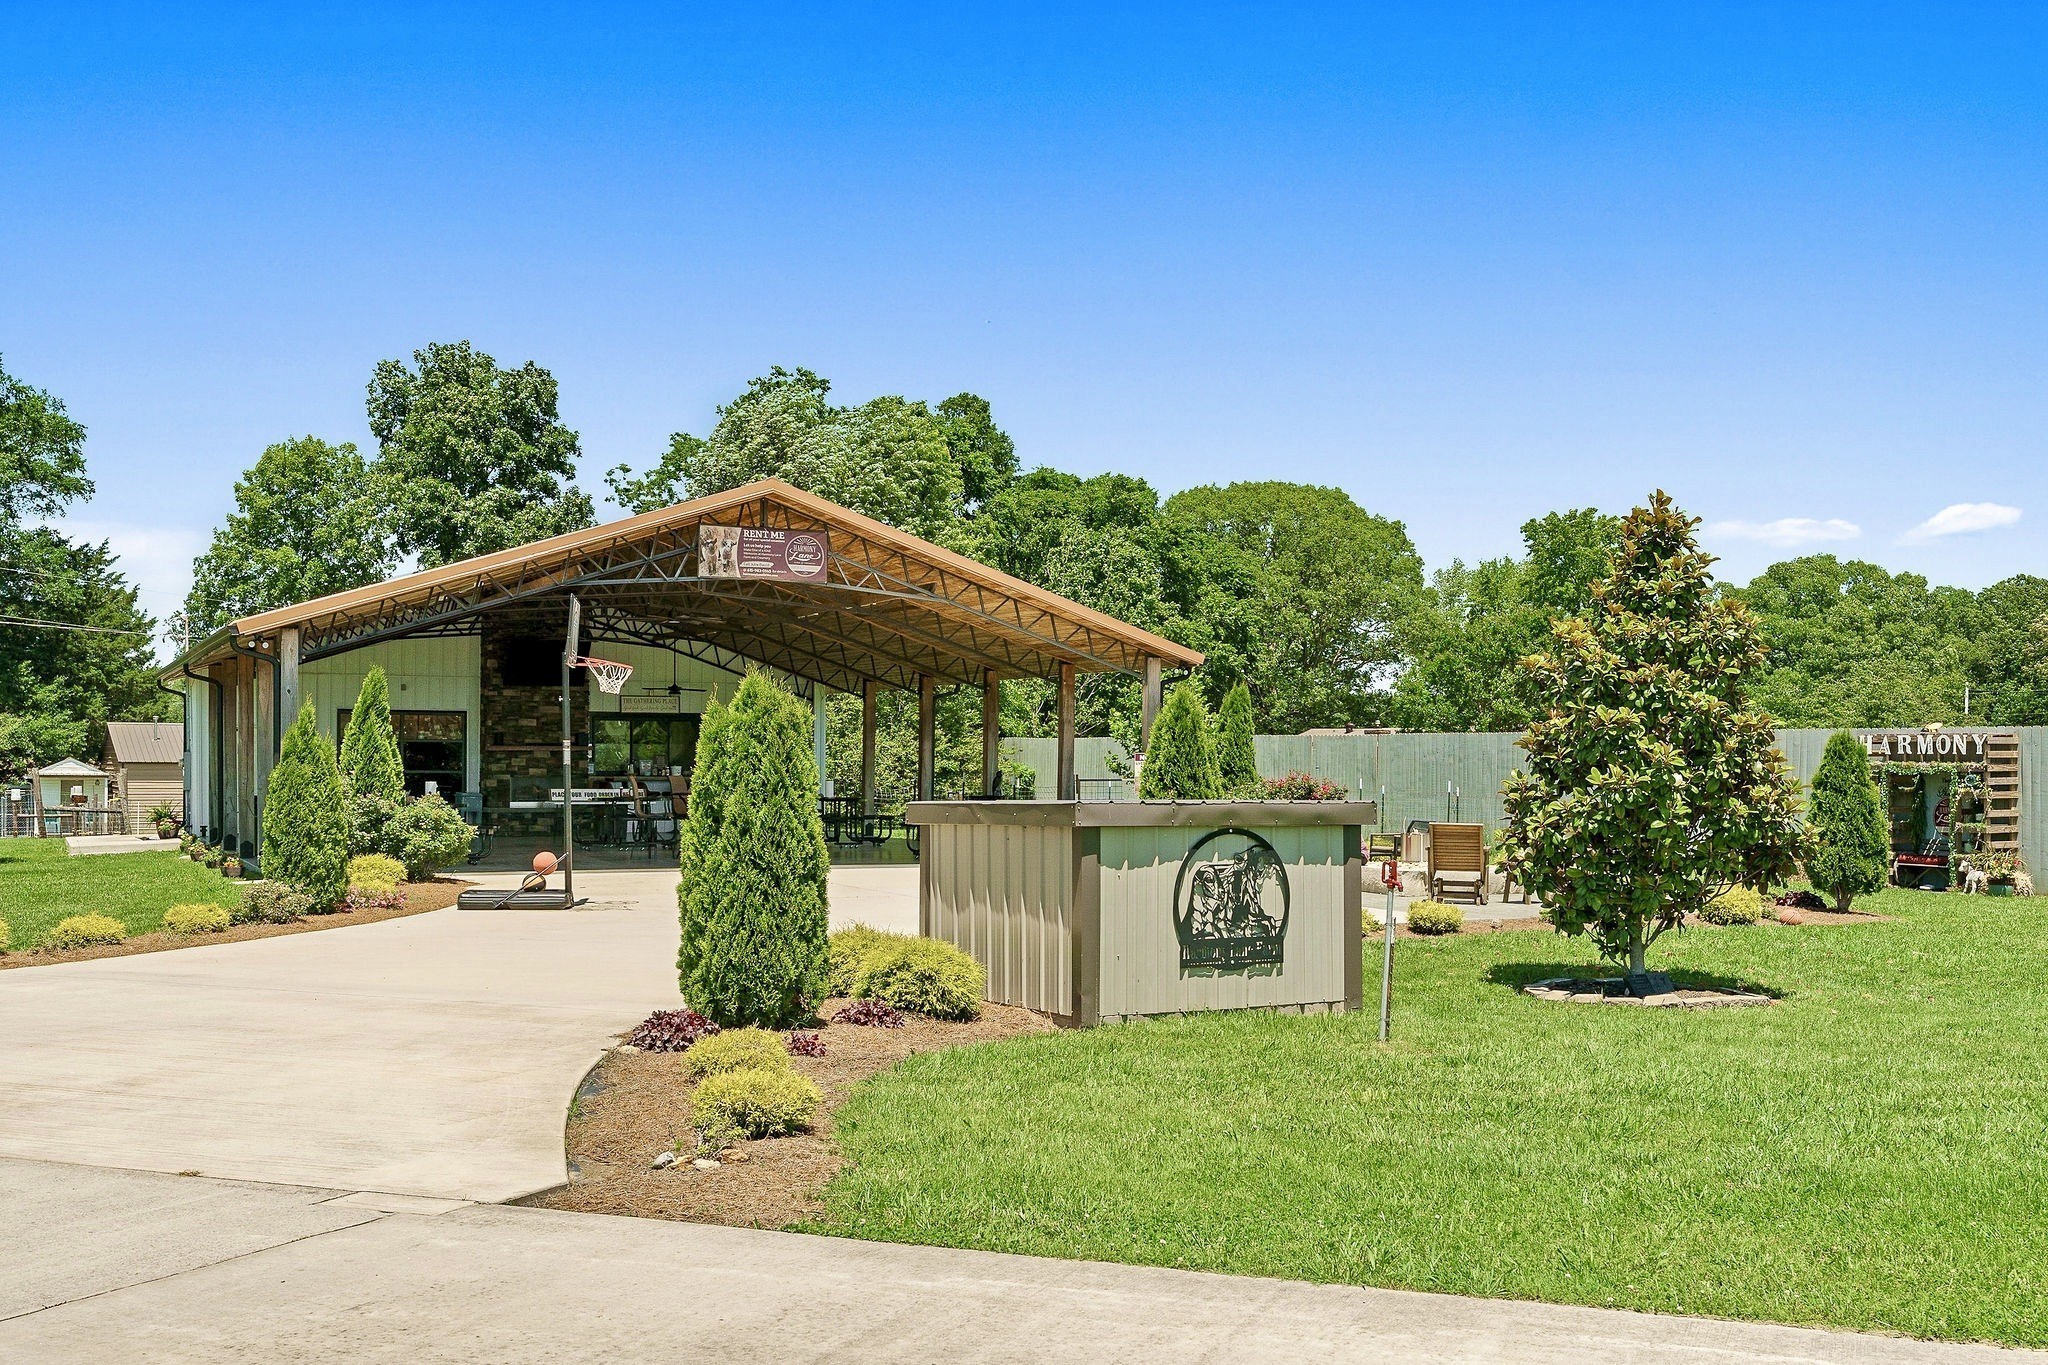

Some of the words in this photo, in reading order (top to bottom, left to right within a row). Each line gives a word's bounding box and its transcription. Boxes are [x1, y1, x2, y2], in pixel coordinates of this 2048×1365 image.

[743, 529, 769, 539] RENT
[770, 531, 785, 539] ME
[793, 544, 816, 553] HARMONY
[789, 548, 821, 561] Lane
[1859, 734, 1987, 755] HARMONY
